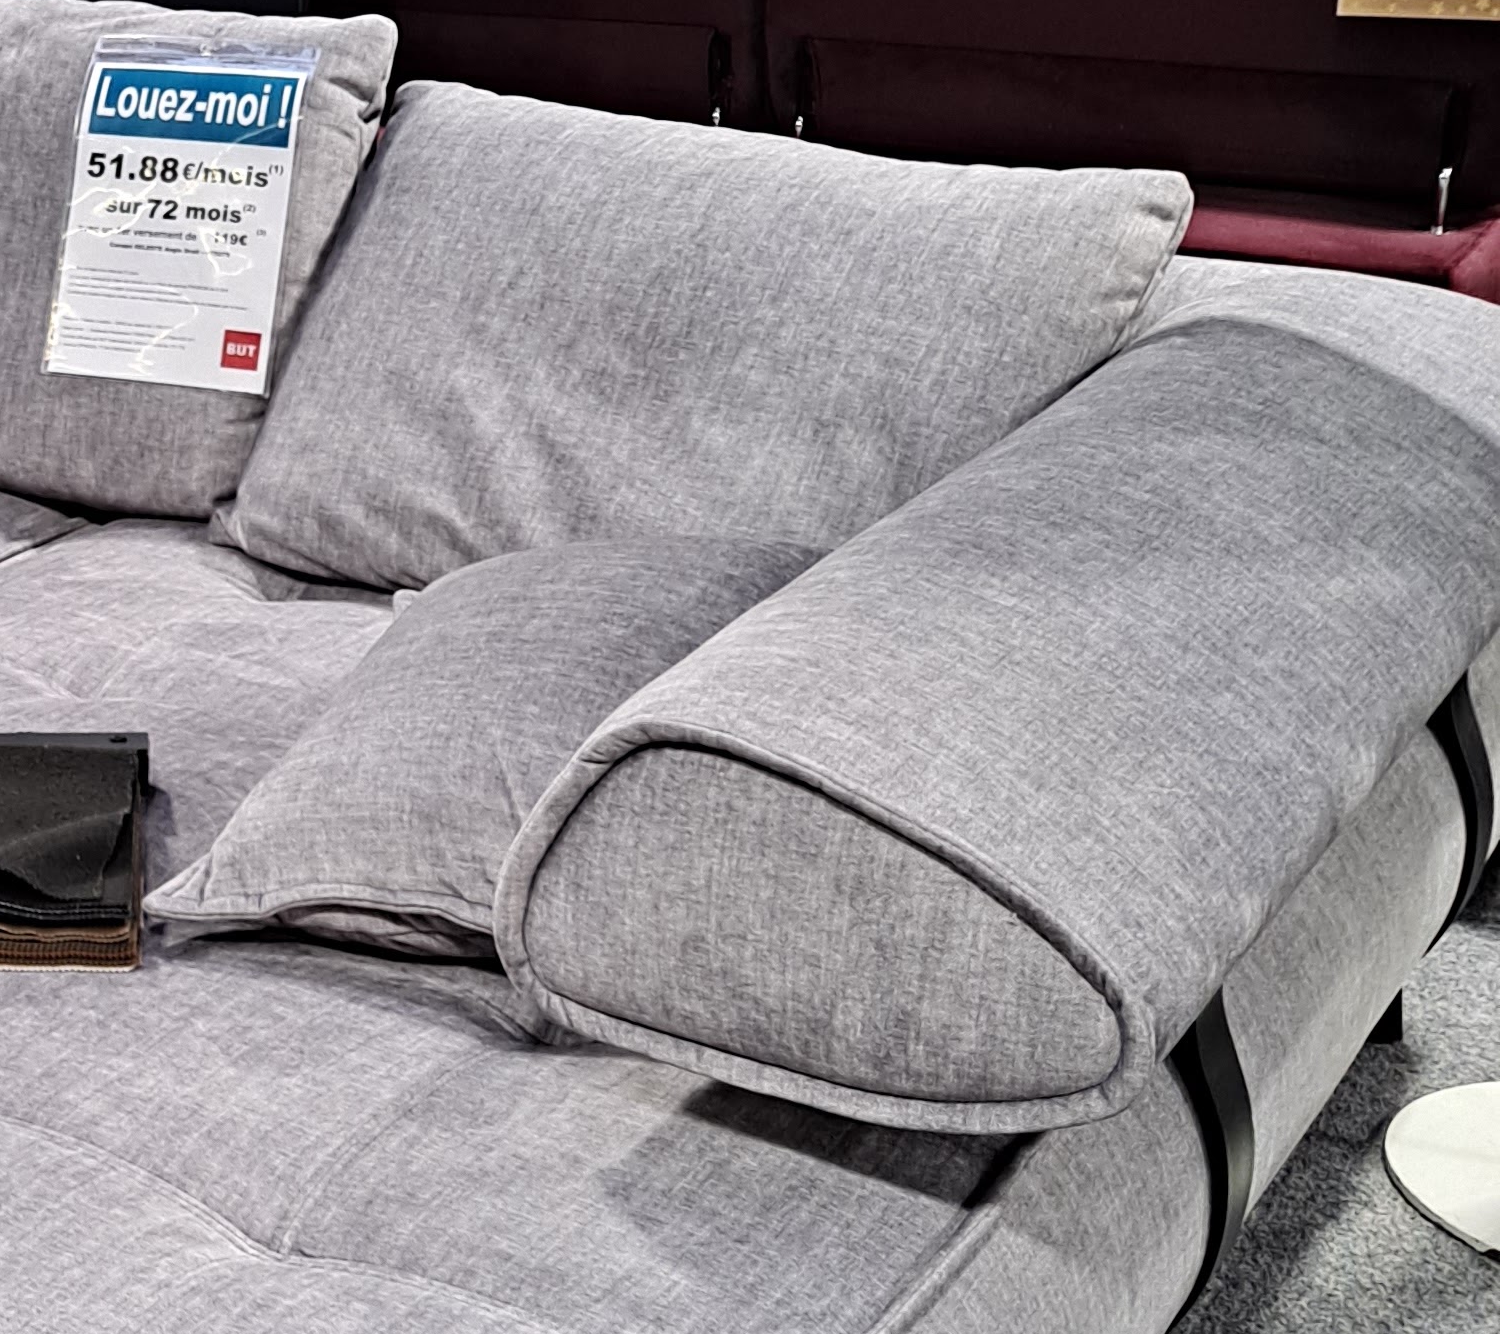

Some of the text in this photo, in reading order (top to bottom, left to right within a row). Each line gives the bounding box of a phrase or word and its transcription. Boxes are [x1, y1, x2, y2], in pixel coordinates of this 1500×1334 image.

[95, 75, 273, 128] Louez-moi
[105, 198, 144, 215] sur
[147, 199, 180, 220] 72
[225, 343, 258, 358] BUT
